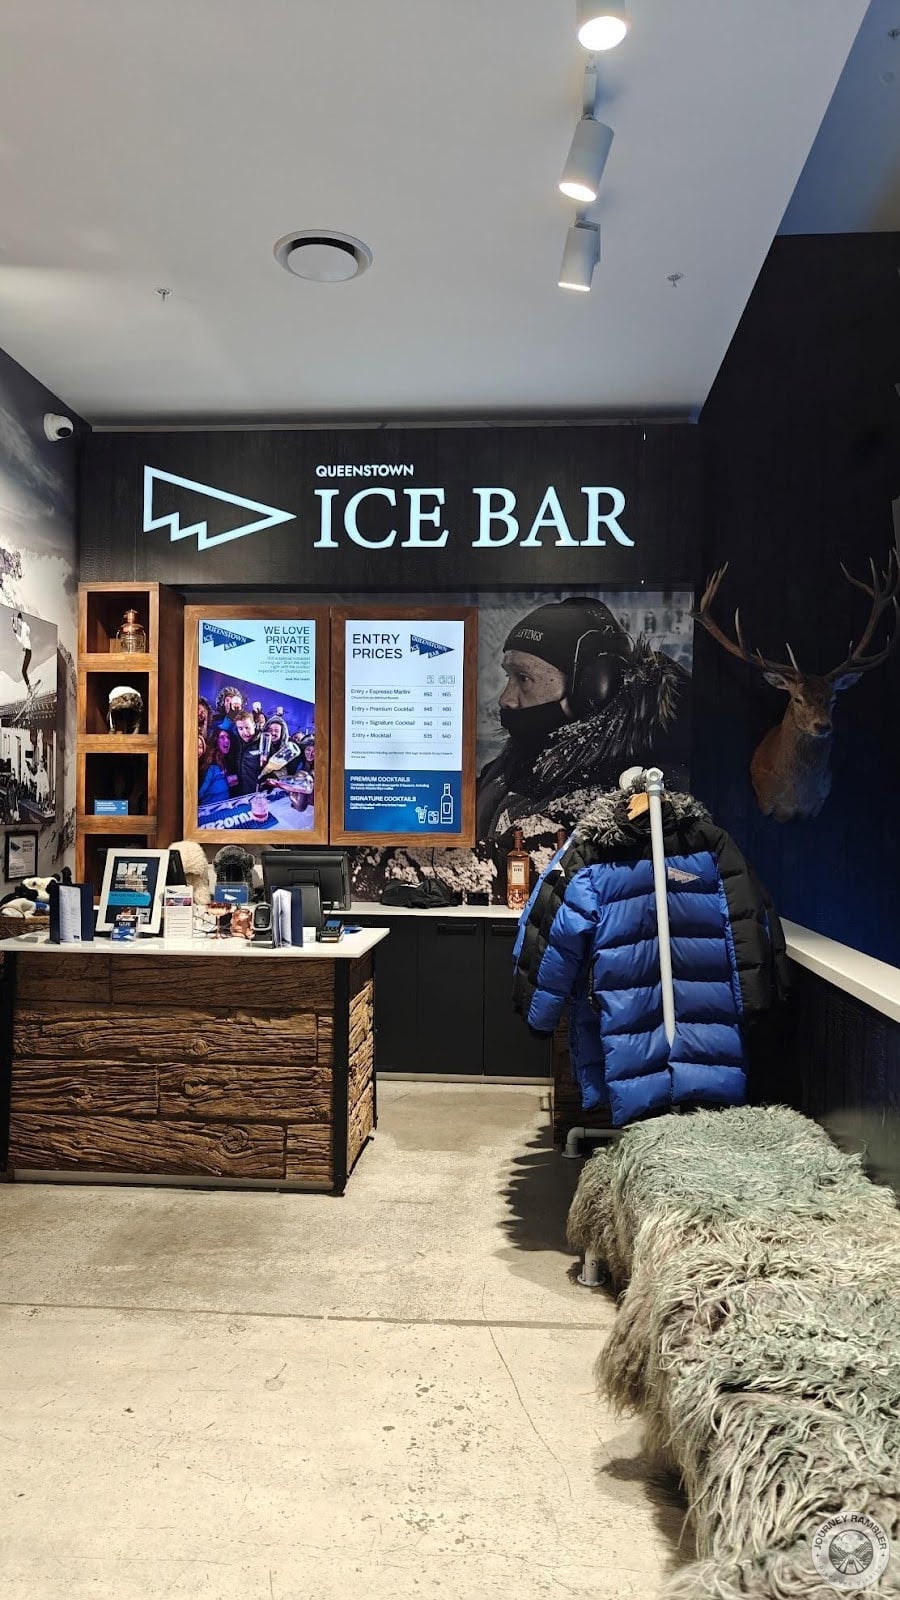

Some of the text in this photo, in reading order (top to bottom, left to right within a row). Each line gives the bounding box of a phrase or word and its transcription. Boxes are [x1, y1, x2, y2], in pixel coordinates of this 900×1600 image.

[316, 464, 414, 477] QUEENSTOWN
[313, 486, 635, 549] ICE BAR
[204, 624, 247, 643] QUEENSTOWN
[264, 626, 310, 635] WE LOVE
[203, 634, 214, 643] ICE
[266, 635, 310, 644] PRIVATE
[352, 633, 400, 645] ENTRY
[411, 635, 448, 652] QUEENSTOWN
[224, 641, 238, 651] BAR
[269, 645, 310, 654] EVENTS
[352, 648, 403, 659] PRICES
[351, 688, 364, 696] Entry
[116, 862, 148, 876] BFF
